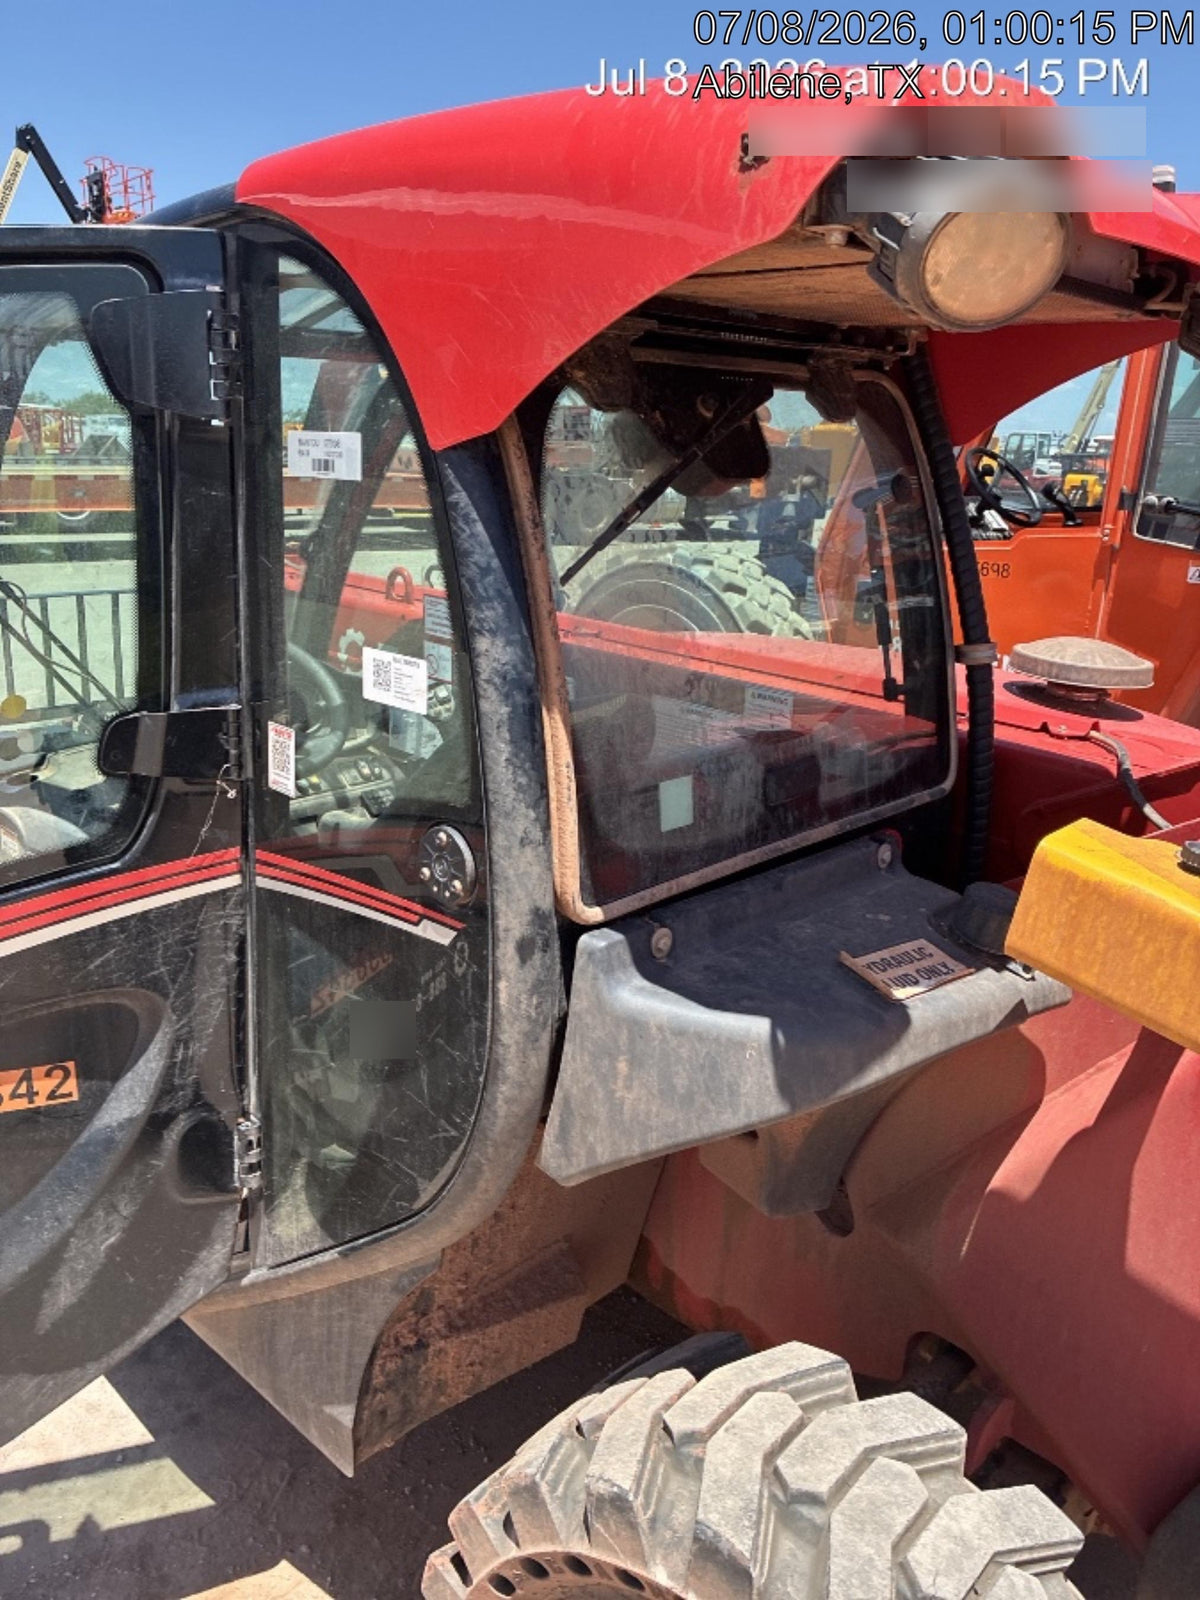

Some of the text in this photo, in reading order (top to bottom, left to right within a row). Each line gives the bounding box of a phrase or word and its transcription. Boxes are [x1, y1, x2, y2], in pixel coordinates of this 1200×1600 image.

[0, 161, 21, 216] entShare
[977, 561, 1011, 578] 698
[915, 961, 955, 980] ONLY
